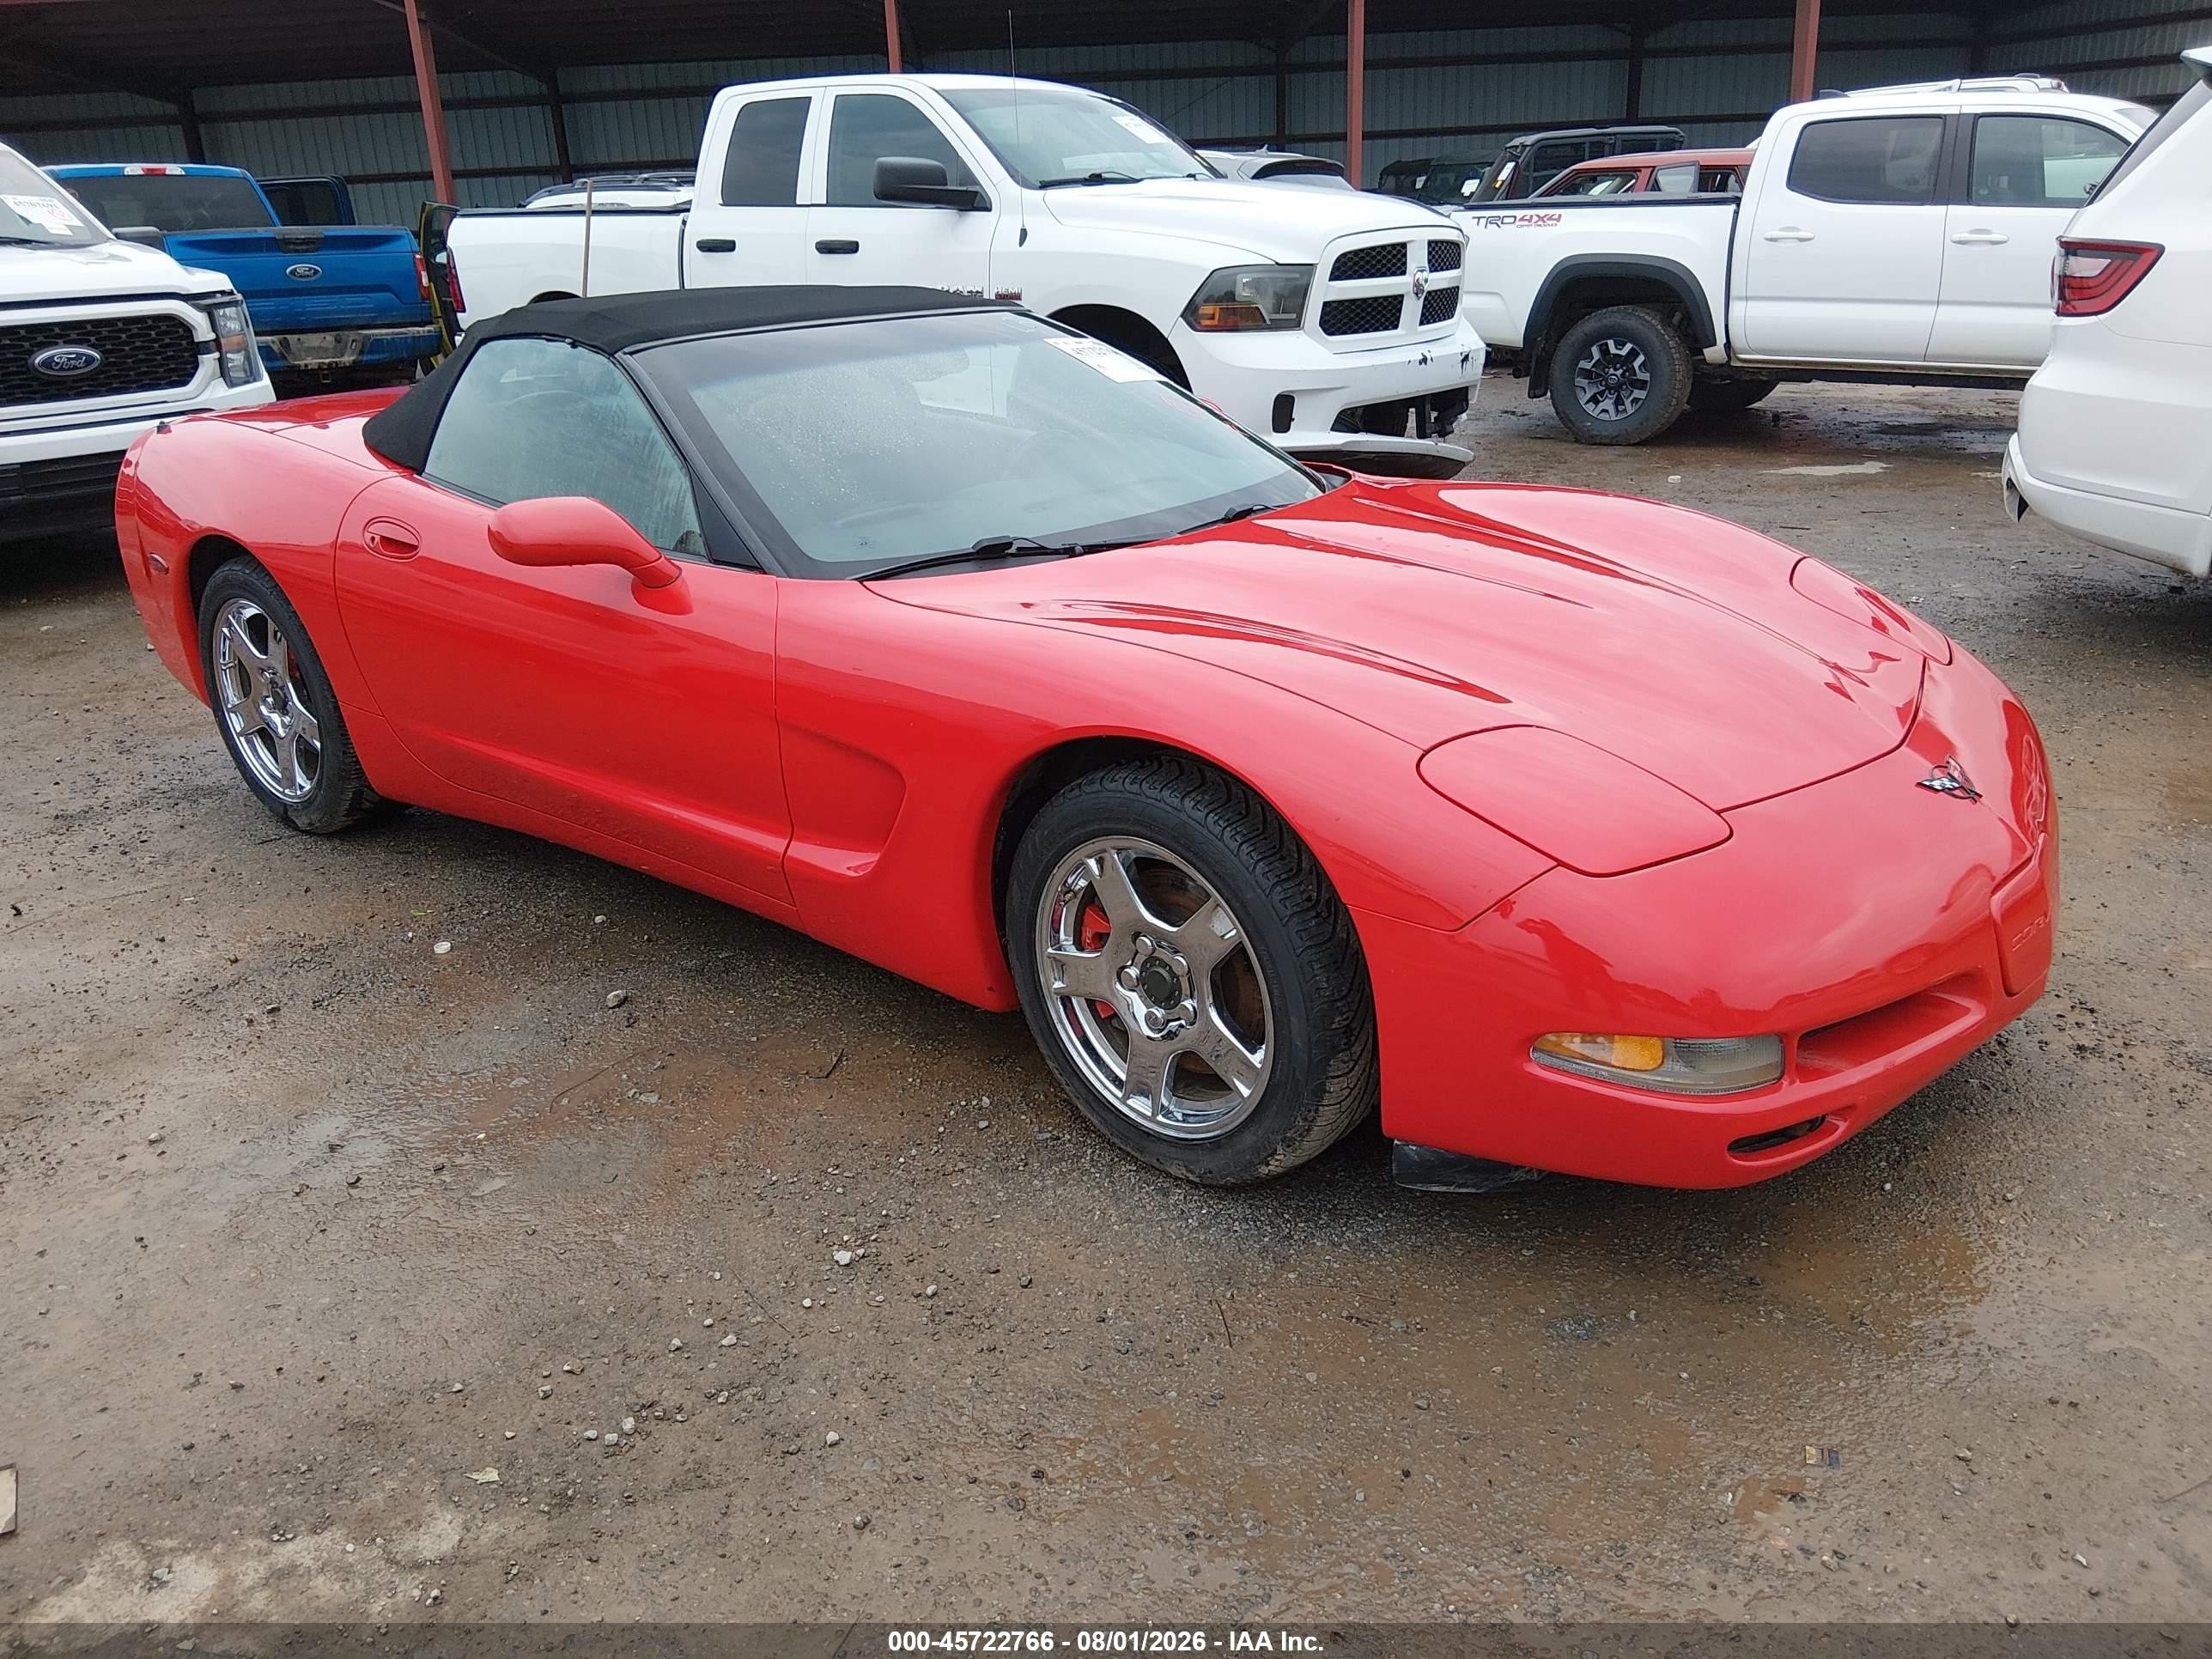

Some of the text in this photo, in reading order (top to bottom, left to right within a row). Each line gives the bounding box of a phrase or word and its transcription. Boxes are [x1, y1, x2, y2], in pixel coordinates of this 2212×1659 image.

[1472, 215, 1517, 228] TRD
[295, 267, 314, 276] Ford
[52, 353, 87, 369] Ford
